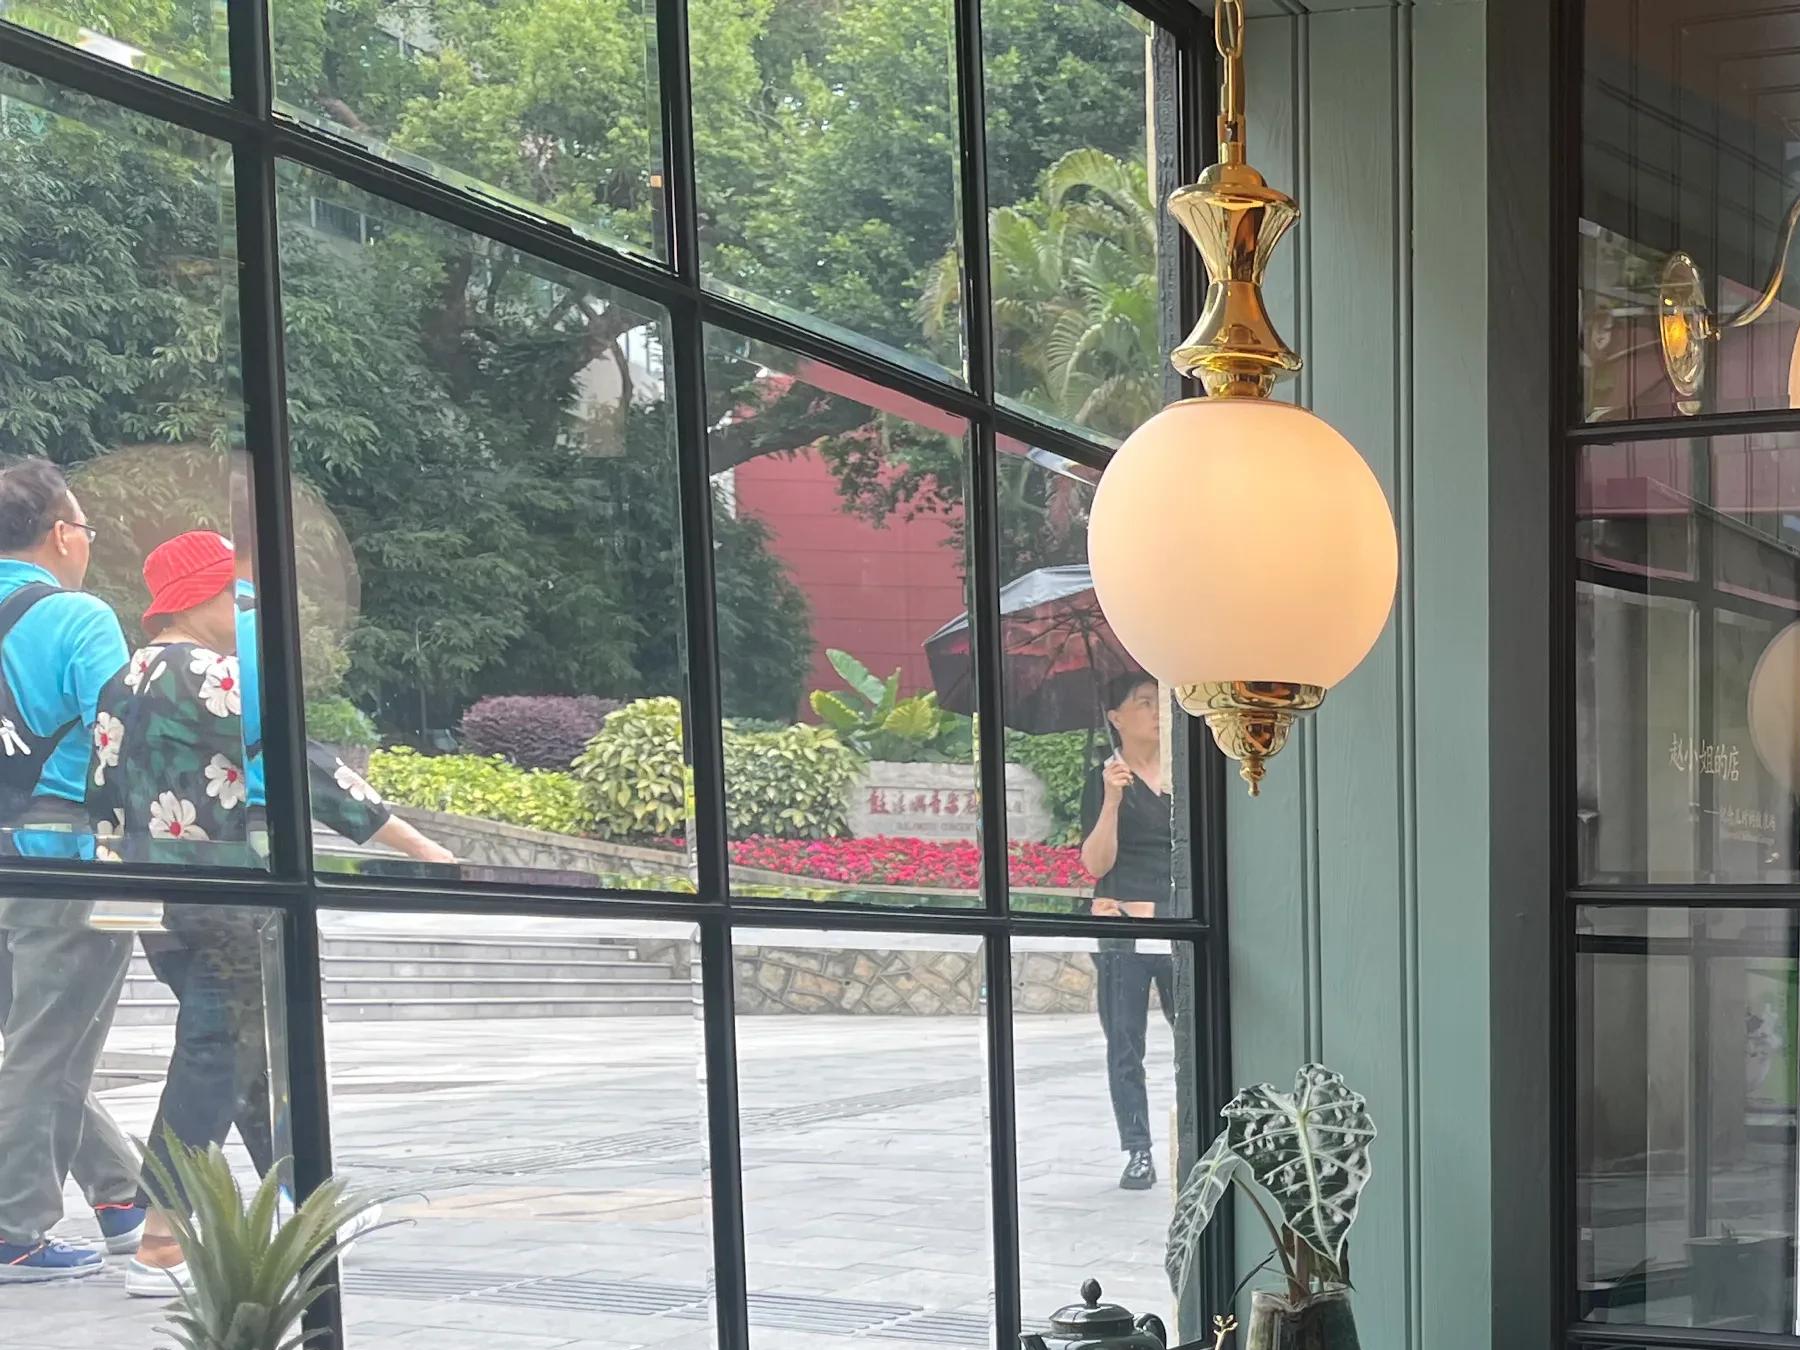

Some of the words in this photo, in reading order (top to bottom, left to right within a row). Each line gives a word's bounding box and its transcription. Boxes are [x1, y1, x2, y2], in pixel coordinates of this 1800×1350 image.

[1669, 733, 1740, 782] 赵小姐的店
